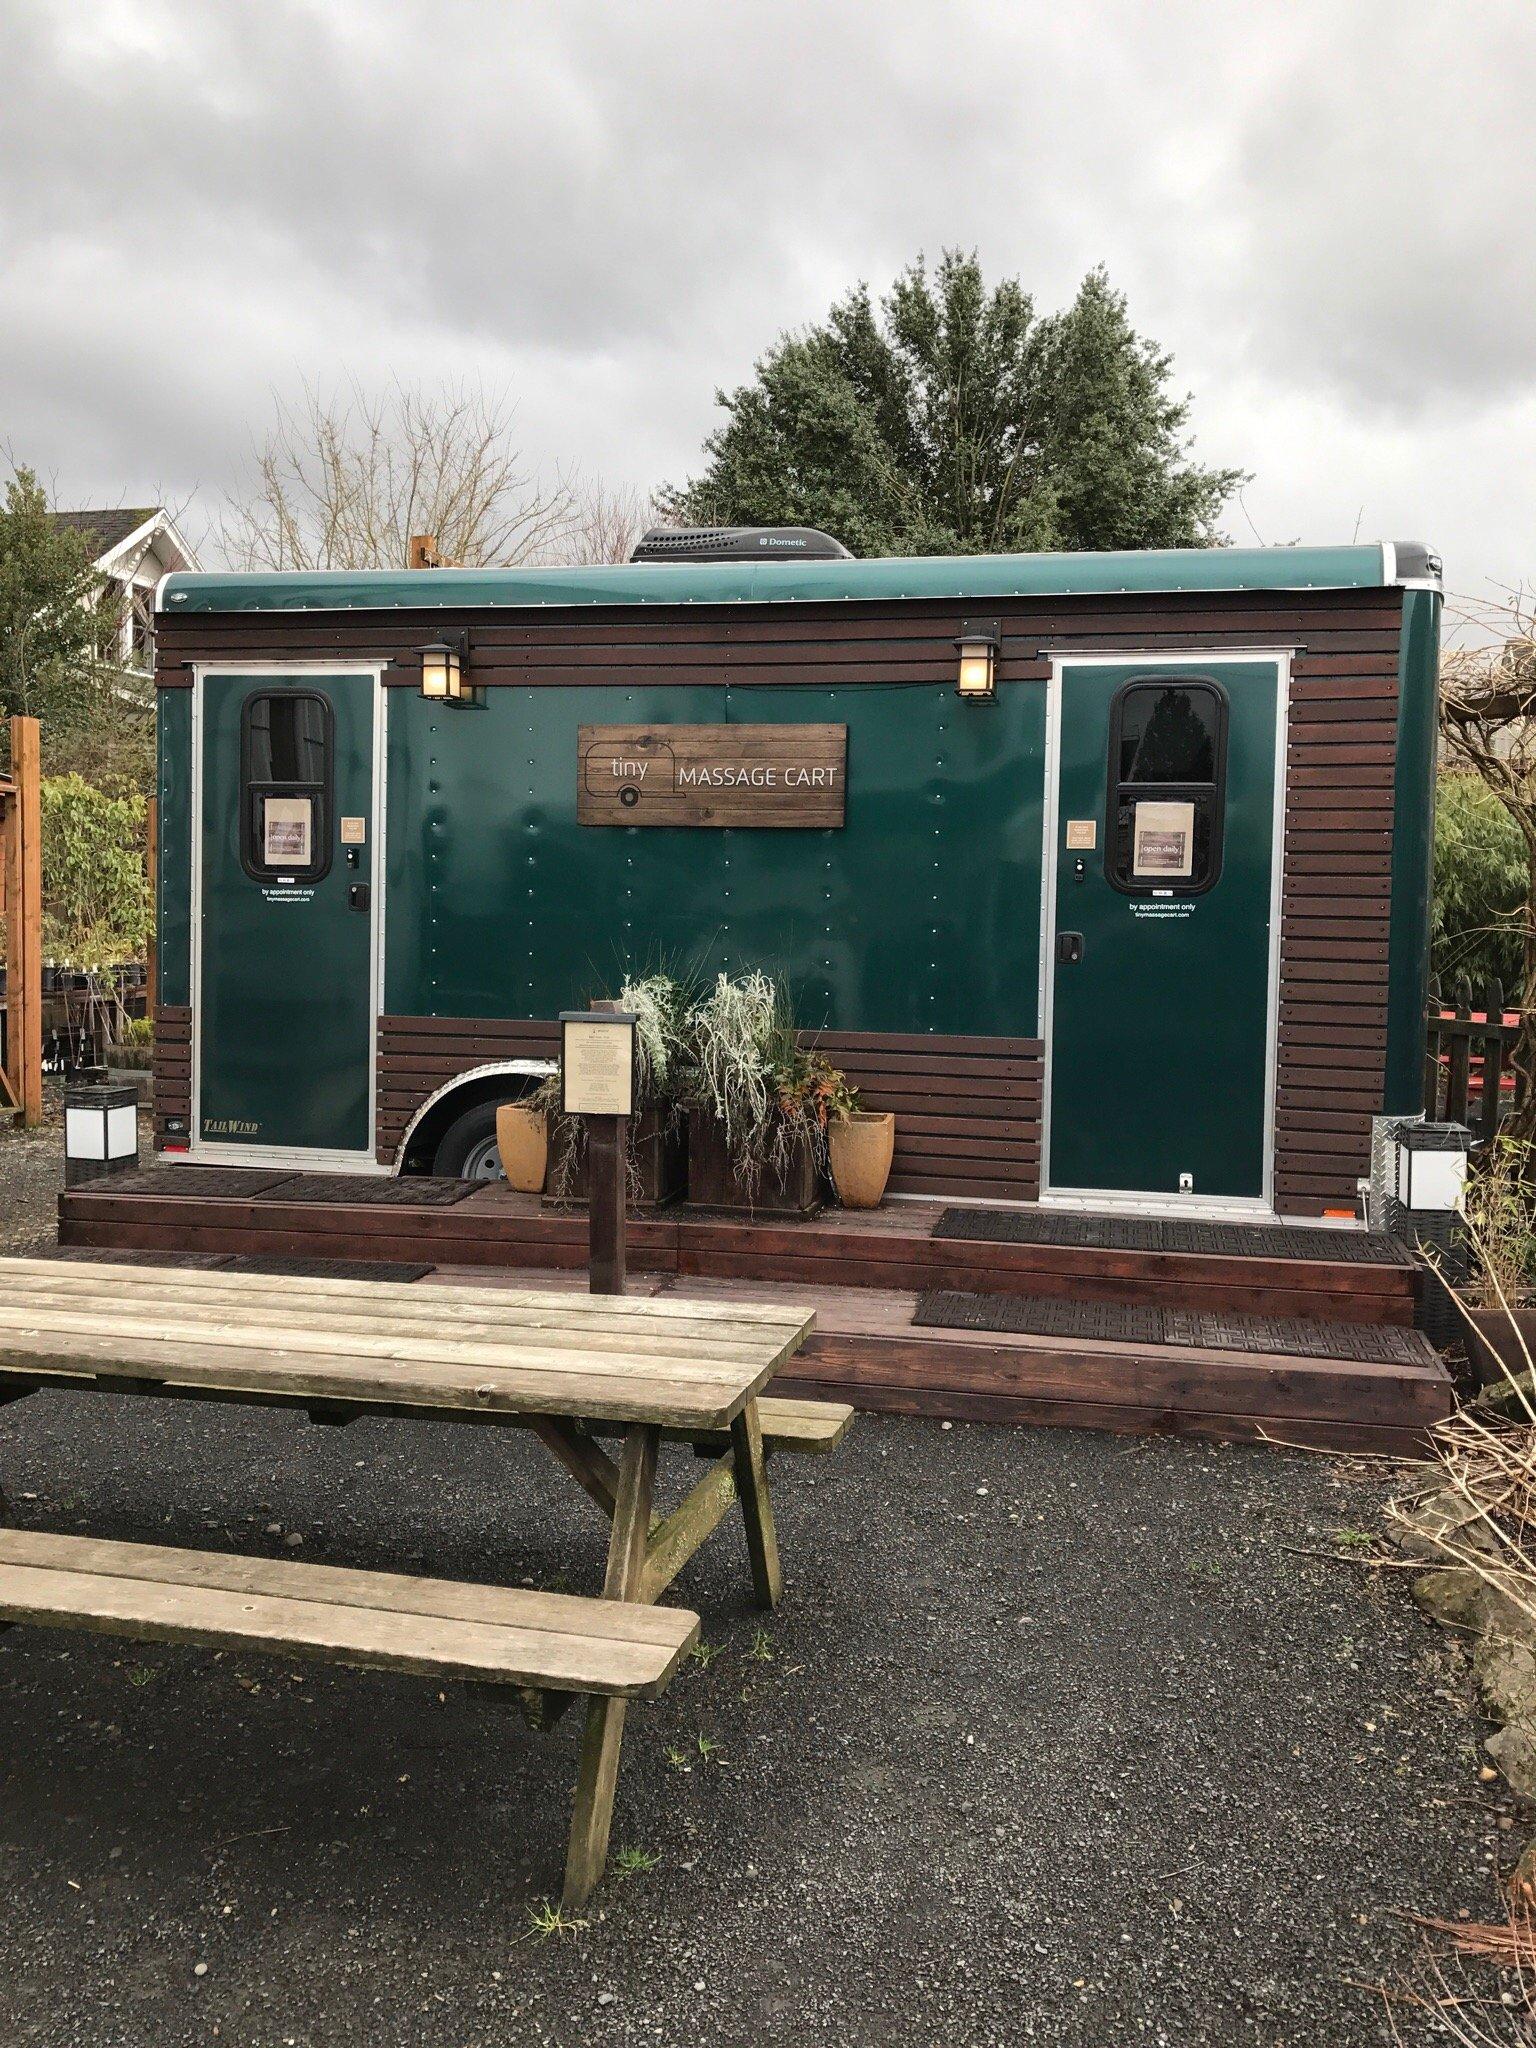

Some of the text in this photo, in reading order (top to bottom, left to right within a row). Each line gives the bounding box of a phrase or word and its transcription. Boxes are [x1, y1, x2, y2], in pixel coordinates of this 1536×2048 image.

[769, 538, 806, 546] Dometic
[611, 757, 837, 786] tiny MASSAGE CART
[1143, 845, 1179, 854] open daily
[1129, 903, 1195, 911] by appointment only
